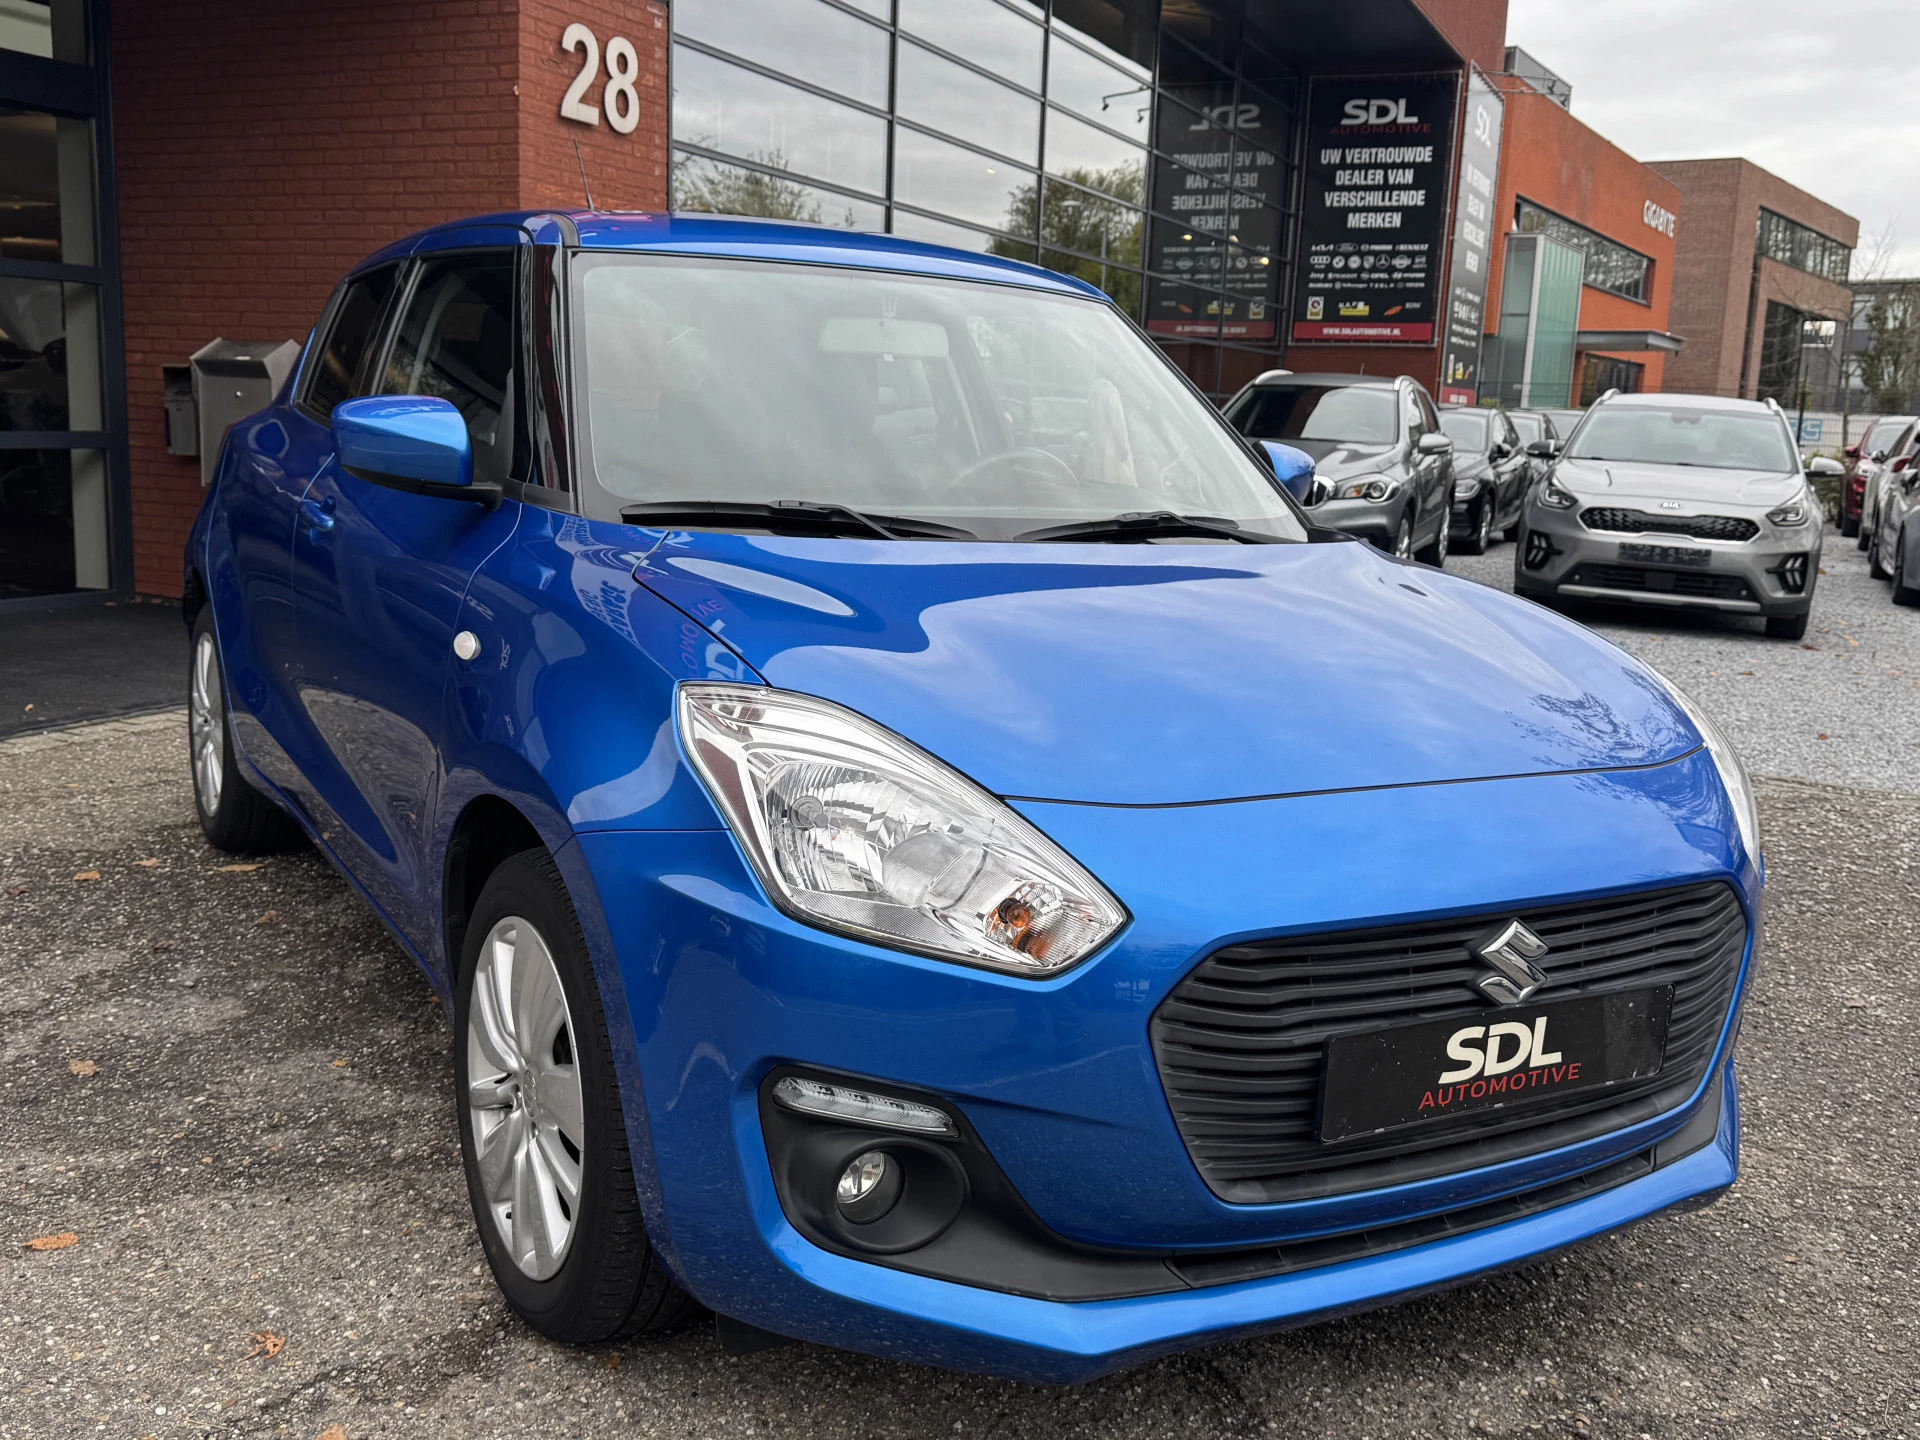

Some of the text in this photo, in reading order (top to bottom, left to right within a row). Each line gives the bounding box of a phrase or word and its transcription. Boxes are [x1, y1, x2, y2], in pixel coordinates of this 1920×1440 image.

[560, 22, 640, 134] 28
[1340, 98, 1419, 125] SDL
[1330, 122, 1432, 135] AUTOMOTIVE
[1320, 146, 1433, 165] UW VERTROUWDE
[1335, 168, 1414, 186] DEALER VAN
[1324, 190, 1426, 207] VERSCHILLENDE
[1347, 212, 1402, 229] MERKEN
[1438, 1016, 1562, 1085] SDL
[1418, 1063, 1582, 1111] AUTOMOTIVE
